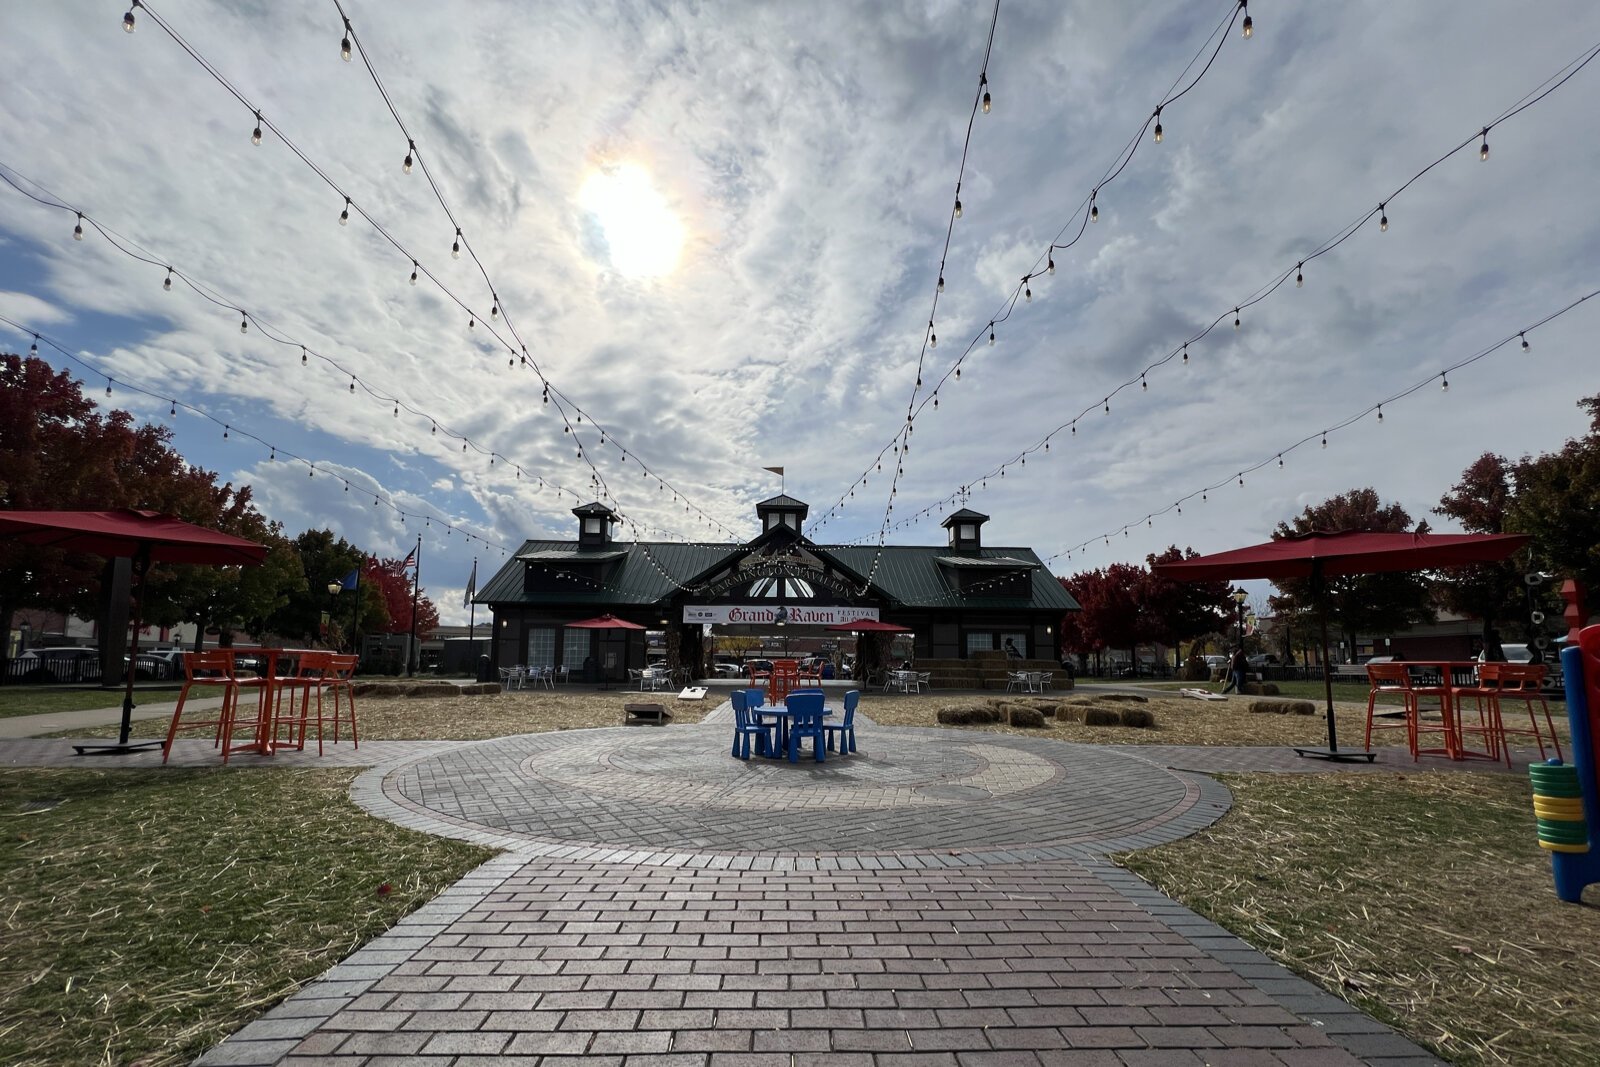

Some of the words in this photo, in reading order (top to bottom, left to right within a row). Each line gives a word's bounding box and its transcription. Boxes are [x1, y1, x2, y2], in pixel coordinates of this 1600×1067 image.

[709, 566, 795, 596] FARMINGTON
[797, 567, 853, 598] PAVILION
[729, 607, 774, 622] Grand
[789, 607, 834, 622] Raven
